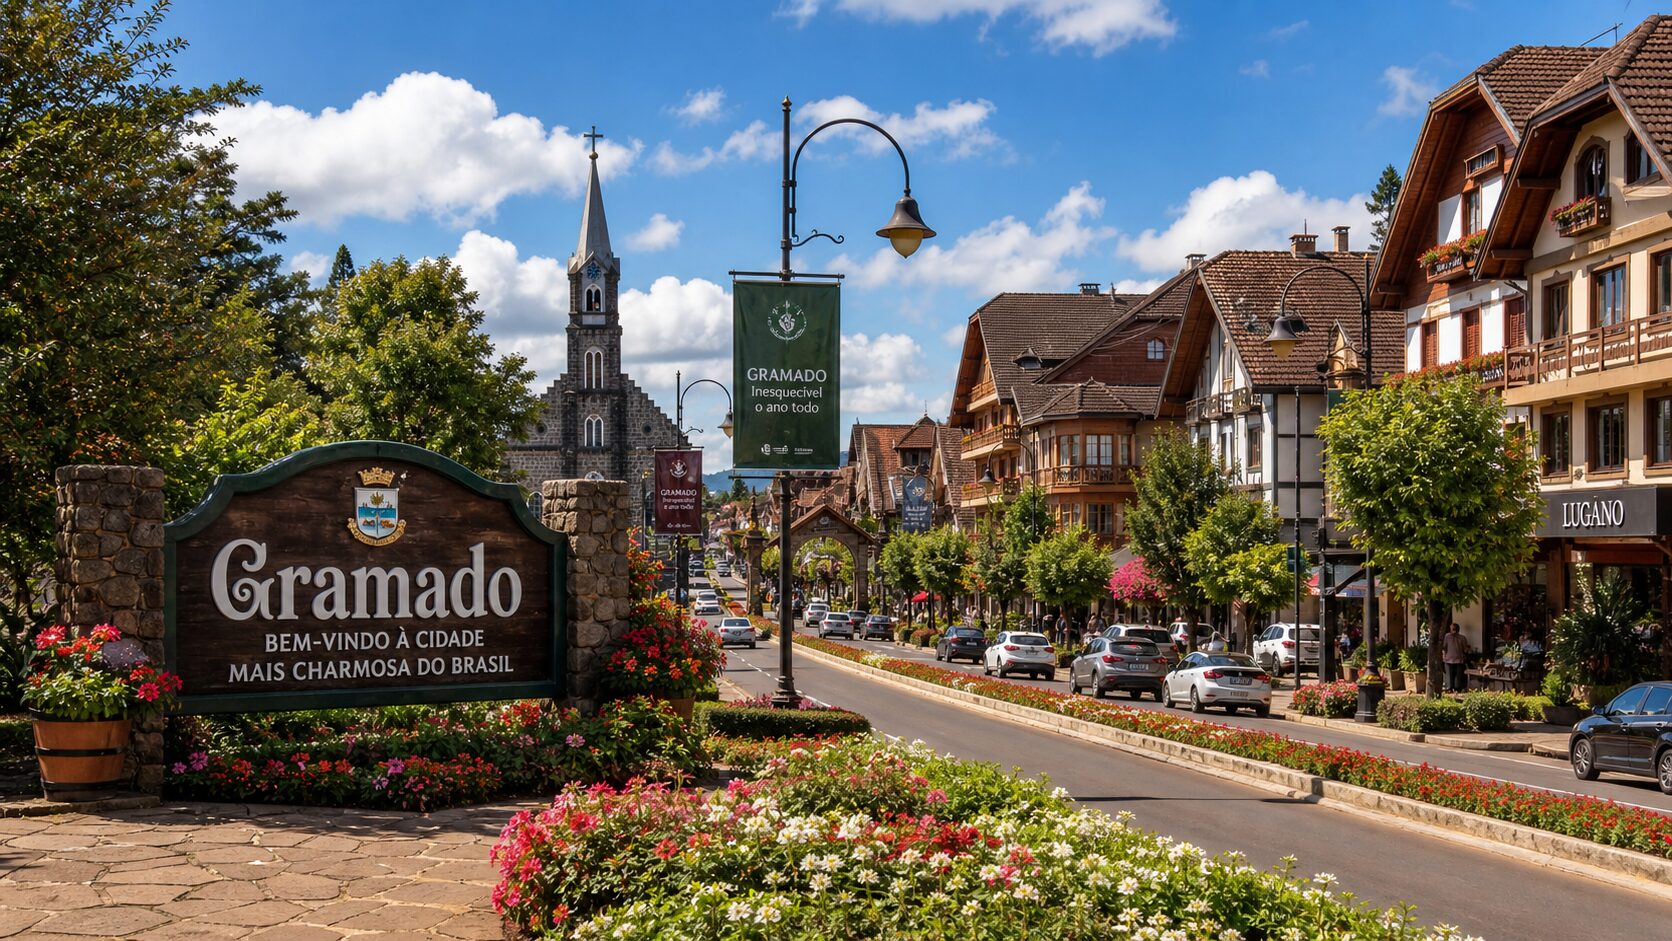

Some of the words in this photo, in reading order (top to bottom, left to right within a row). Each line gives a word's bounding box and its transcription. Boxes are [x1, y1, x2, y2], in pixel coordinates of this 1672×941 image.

[747, 367, 827, 382] GRAMADO
[755, 403, 763, 412] o
[766, 403, 788, 413] ano
[792, 401, 819, 413] todo
[211, 538, 522, 621] Gramado
[265, 631, 390, 652] BEM-VINDO
[396, 626, 410, 649] À
[416, 630, 484, 649] CIDADE
[228, 662, 285, 683] MAIS
[292, 658, 411, 680] CHARMOSA
[417, 657, 445, 676] DO
[452, 655, 515, 675] BRASIL
